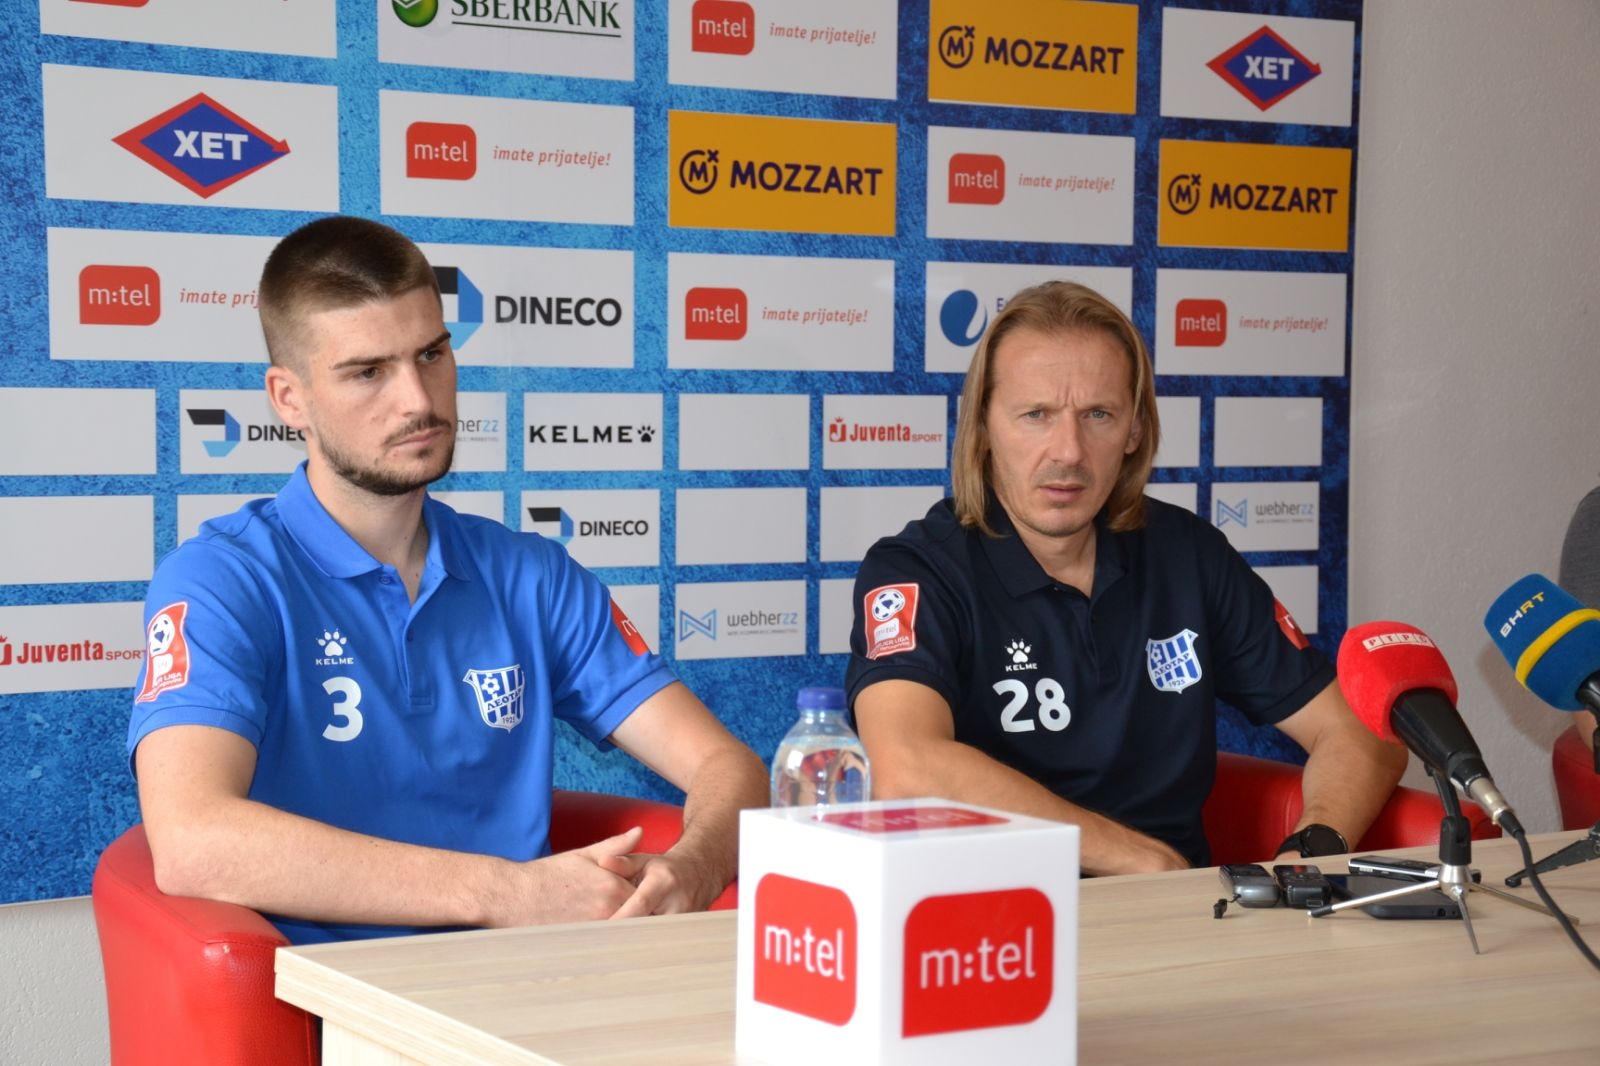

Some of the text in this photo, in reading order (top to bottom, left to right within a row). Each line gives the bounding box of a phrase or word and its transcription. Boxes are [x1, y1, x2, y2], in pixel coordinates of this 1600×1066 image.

[451, 0, 621, 29] SBERBANK
[698, 17, 747, 38] m:tel
[768, 23, 876, 46] imate prijatelje!
[985, 36, 1124, 74] MOZZART
[1244, 55, 1295, 81] XET
[173, 130, 248, 161] XET
[414, 140, 468, 163] m:tel
[493, 146, 611, 168] imate prijatelje!
[730, 160, 883, 195] MOZZART
[954, 167, 999, 191] m:tel
[1018, 172, 1115, 194] imate prijatelje!
[1210, 183, 1338, 214] MOZZART
[88, 284, 151, 306] m:tel
[180, 288, 226, 304] imate
[495, 295, 622, 327] DINECO
[692, 303, 740, 323] m:tel
[762, 306, 868, 327] imate prijatelje!
[1181, 315, 1220, 333] m:tel
[1239, 315, 1328, 334] imate prijatelje!
[248, 425, 306, 441] DINE
[529, 424, 634, 443] KELME
[850, 423, 910, 442] Juventa
[912, 433, 943, 443] SPORT
[1256, 501, 1313, 515] webherzz
[579, 519, 649, 538] DINECO
[727, 610, 798, 627] webherzz
[1500, 592, 1544, 637] BHRT
[17, 640, 103, 664] Juventa
[315, 658, 354, 666] KELME
[1005, 662, 1037, 671] KELME
[322, 676, 364, 742] 3
[992, 677, 1071, 733] 28
[765, 925, 845, 981] m:tel
[920, 926, 1036, 990] m:tel
